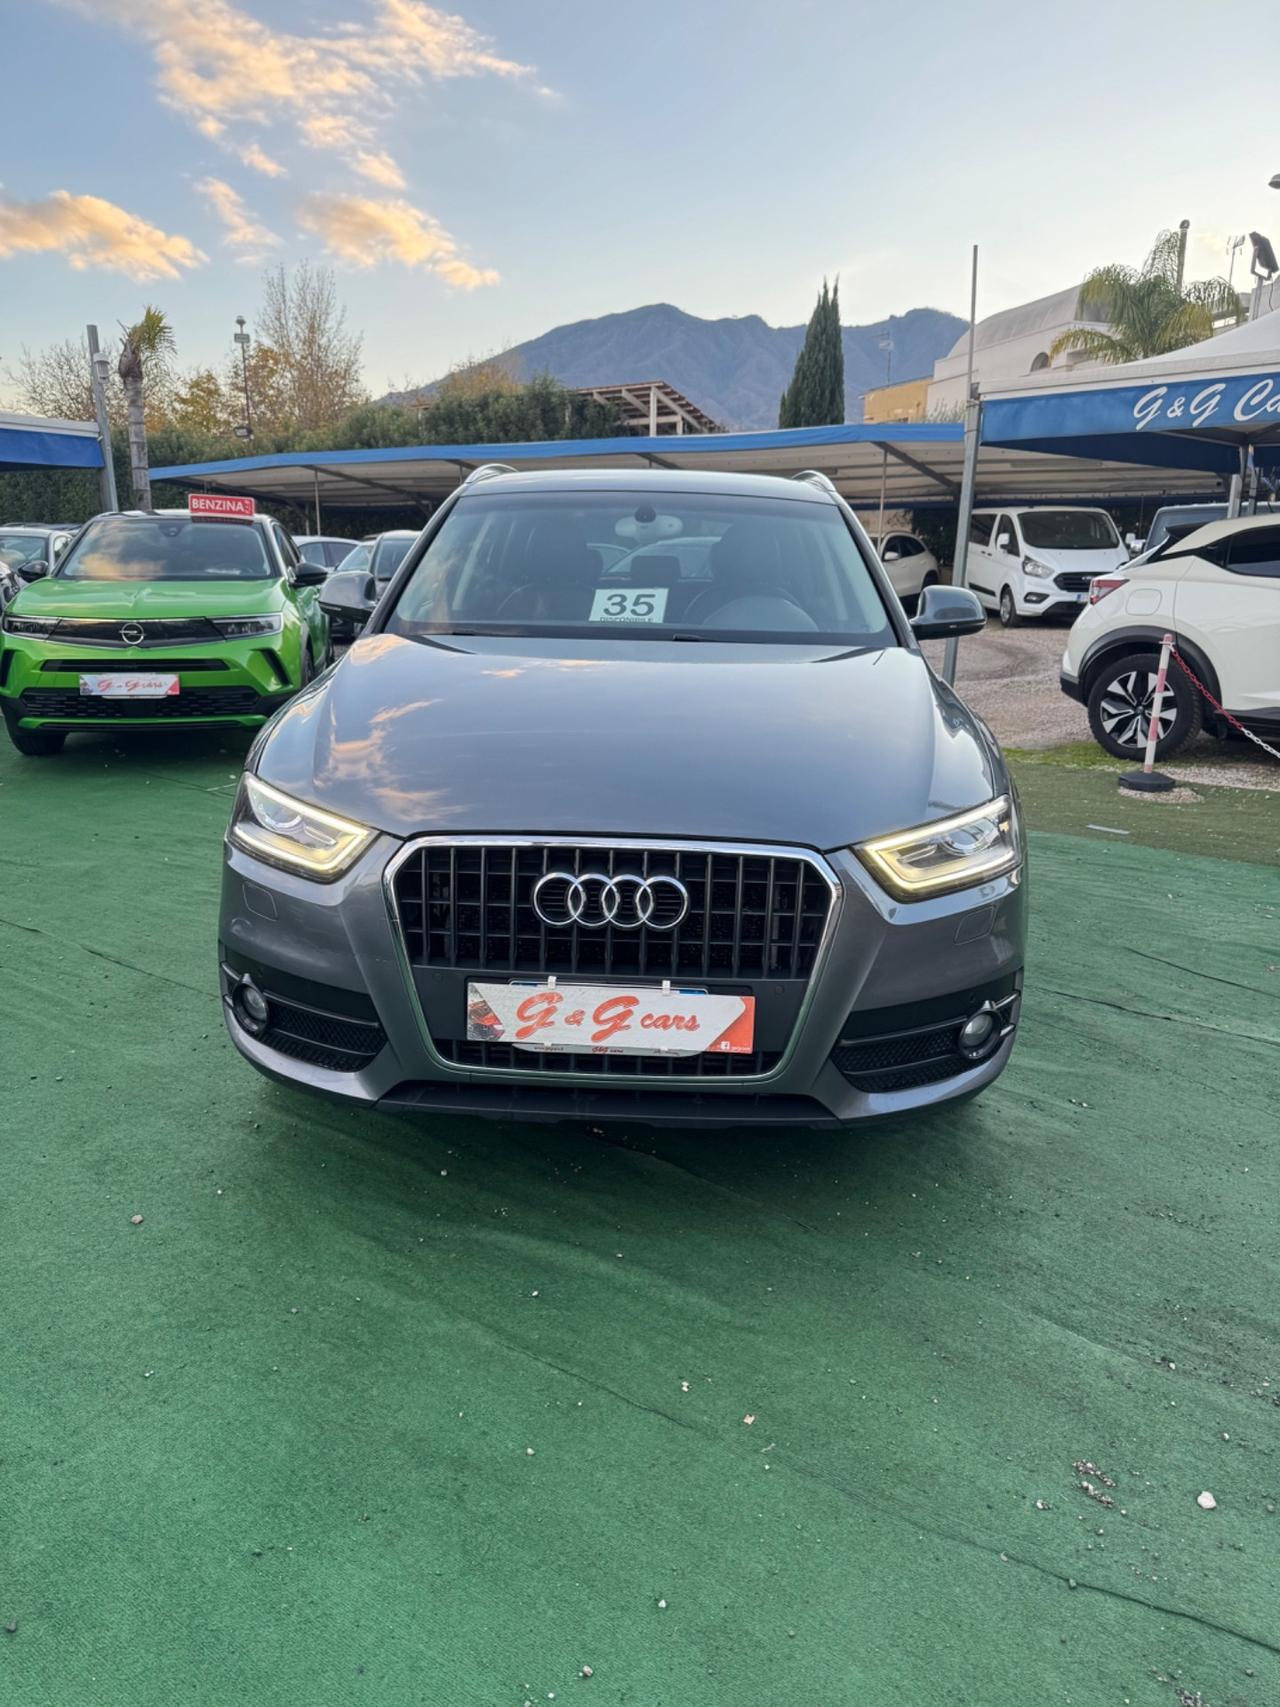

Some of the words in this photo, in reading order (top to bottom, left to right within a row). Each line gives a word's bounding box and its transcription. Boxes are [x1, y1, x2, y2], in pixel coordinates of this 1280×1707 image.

[192, 499, 244, 512] BENZINA
[603, 594, 656, 616] 35
[515, 992, 564, 1040] G
[564, 1009, 585, 1026] &
[591, 995, 640, 1043] G
[640, 1012, 700, 1032] cars
